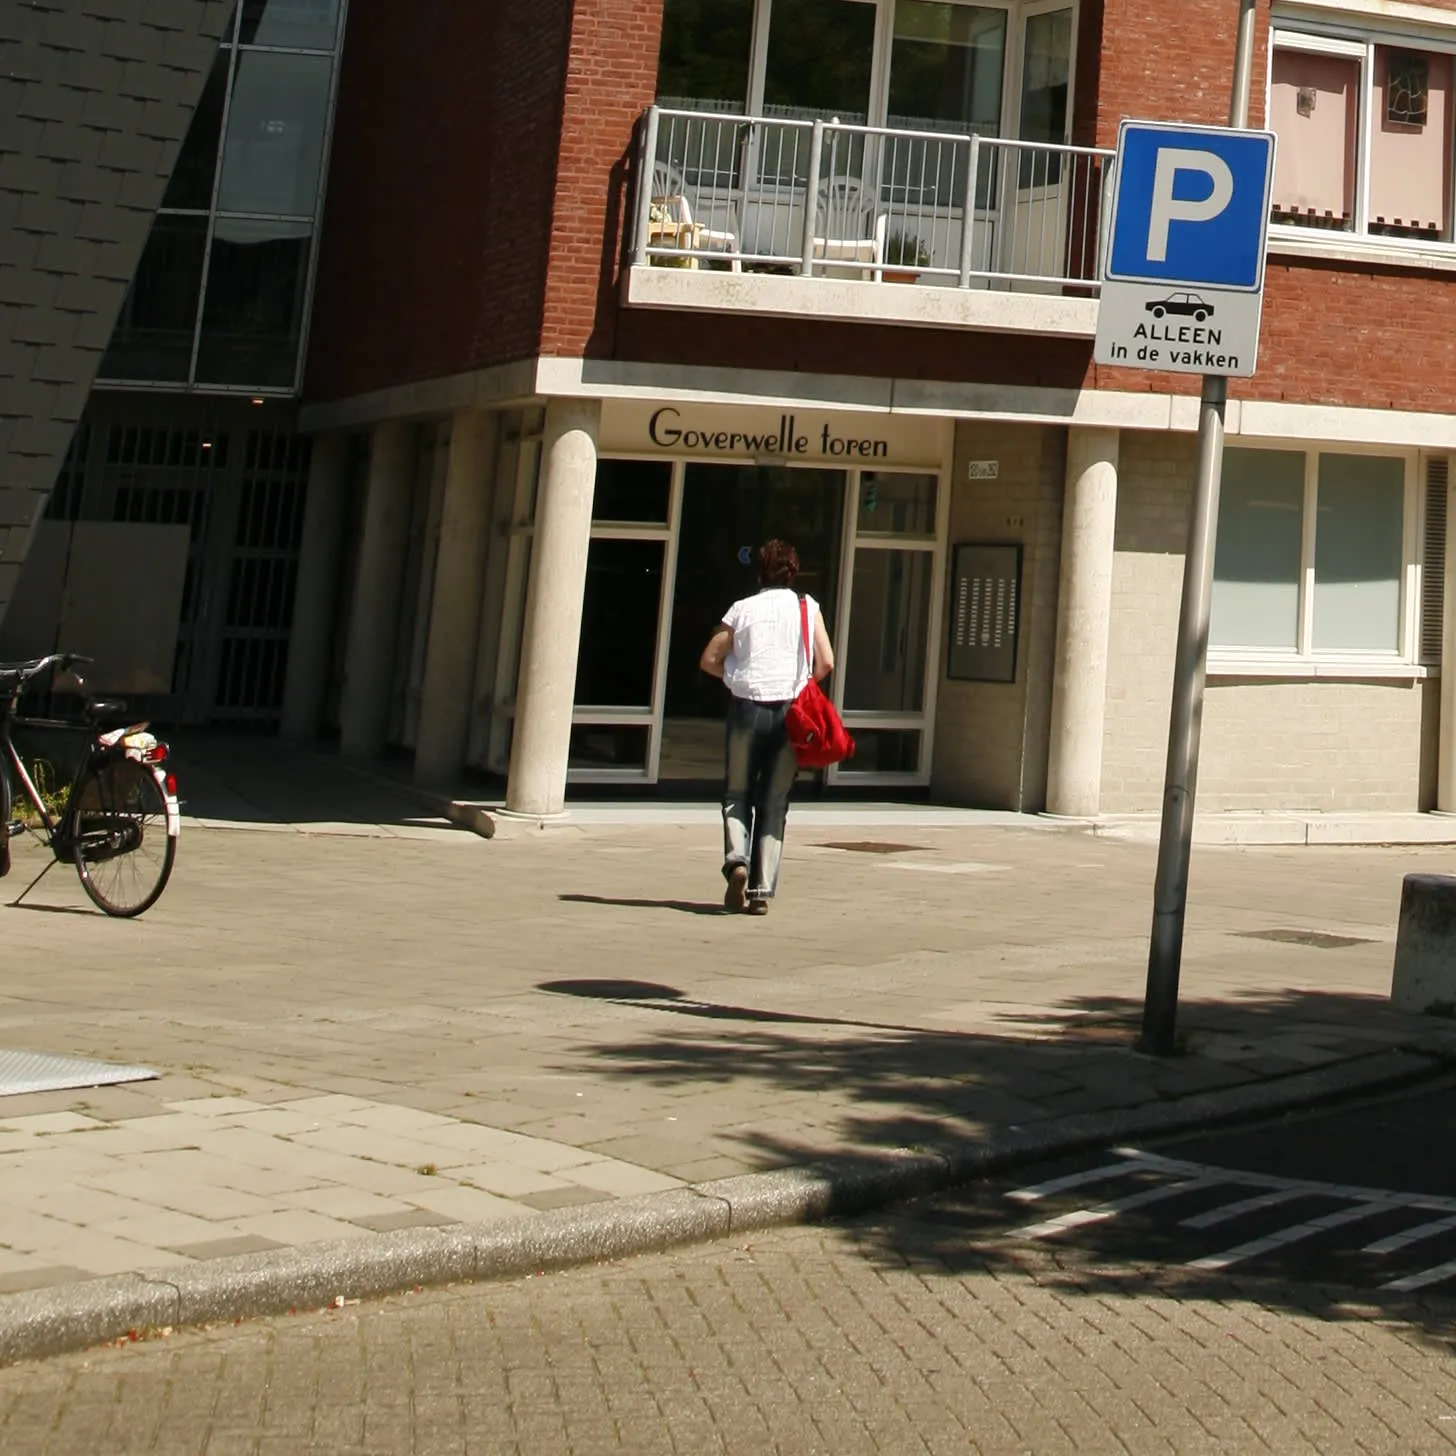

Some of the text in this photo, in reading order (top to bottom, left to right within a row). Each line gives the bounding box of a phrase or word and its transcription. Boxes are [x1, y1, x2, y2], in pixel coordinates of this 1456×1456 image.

[1146, 147, 1234, 262] P
[1133, 322, 1222, 345] ALLEEN
[1110, 342, 1239, 369] in de vakken
[648, 407, 888, 457] Goverwelle toren
